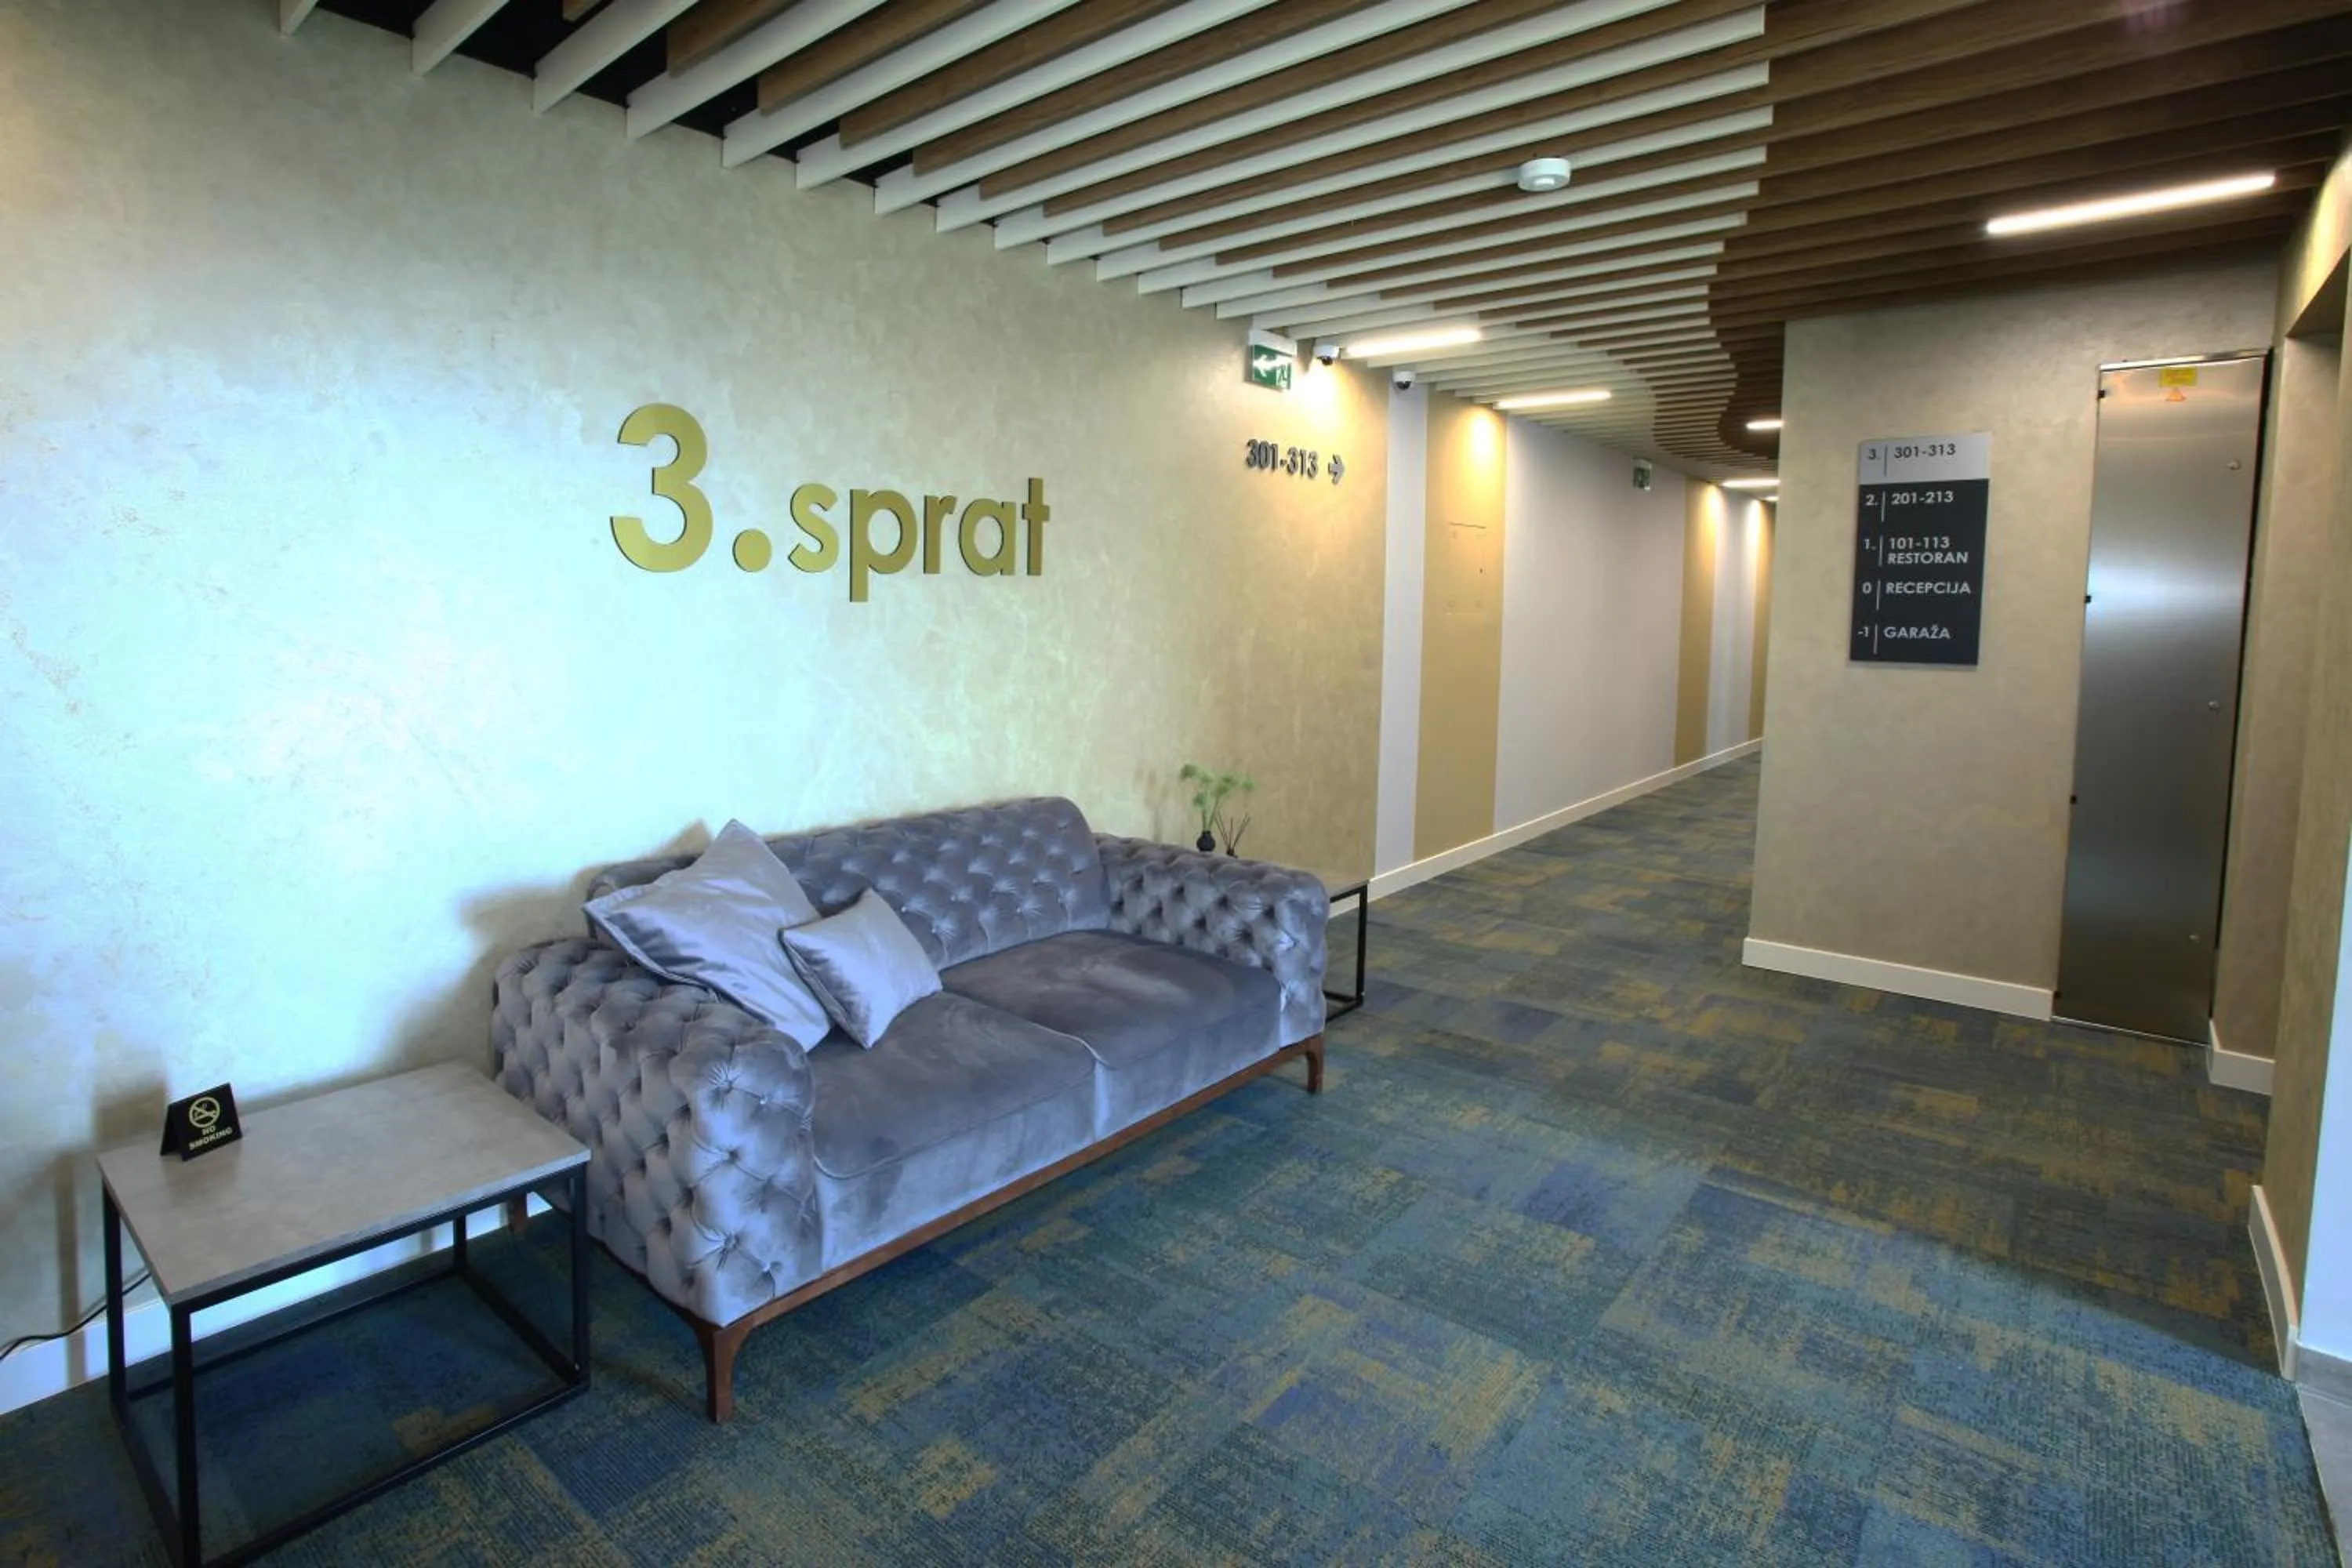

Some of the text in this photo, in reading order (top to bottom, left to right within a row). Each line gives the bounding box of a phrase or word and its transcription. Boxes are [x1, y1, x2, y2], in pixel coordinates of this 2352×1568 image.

[1245, 438, 1319, 479] 301-313
[1867, 443, 1956, 460] 3. 301-313
[1865, 491, 1955, 506] 2. 201-213
[1889, 536, 1951, 550] 101-113
[1887, 551, 1969, 564] RESTORAN
[1886, 582, 1971, 594] RECEPCIJA
[1883, 623, 1951, 639] GARAŽA
[189, 1127, 233, 1150] SMOKING
